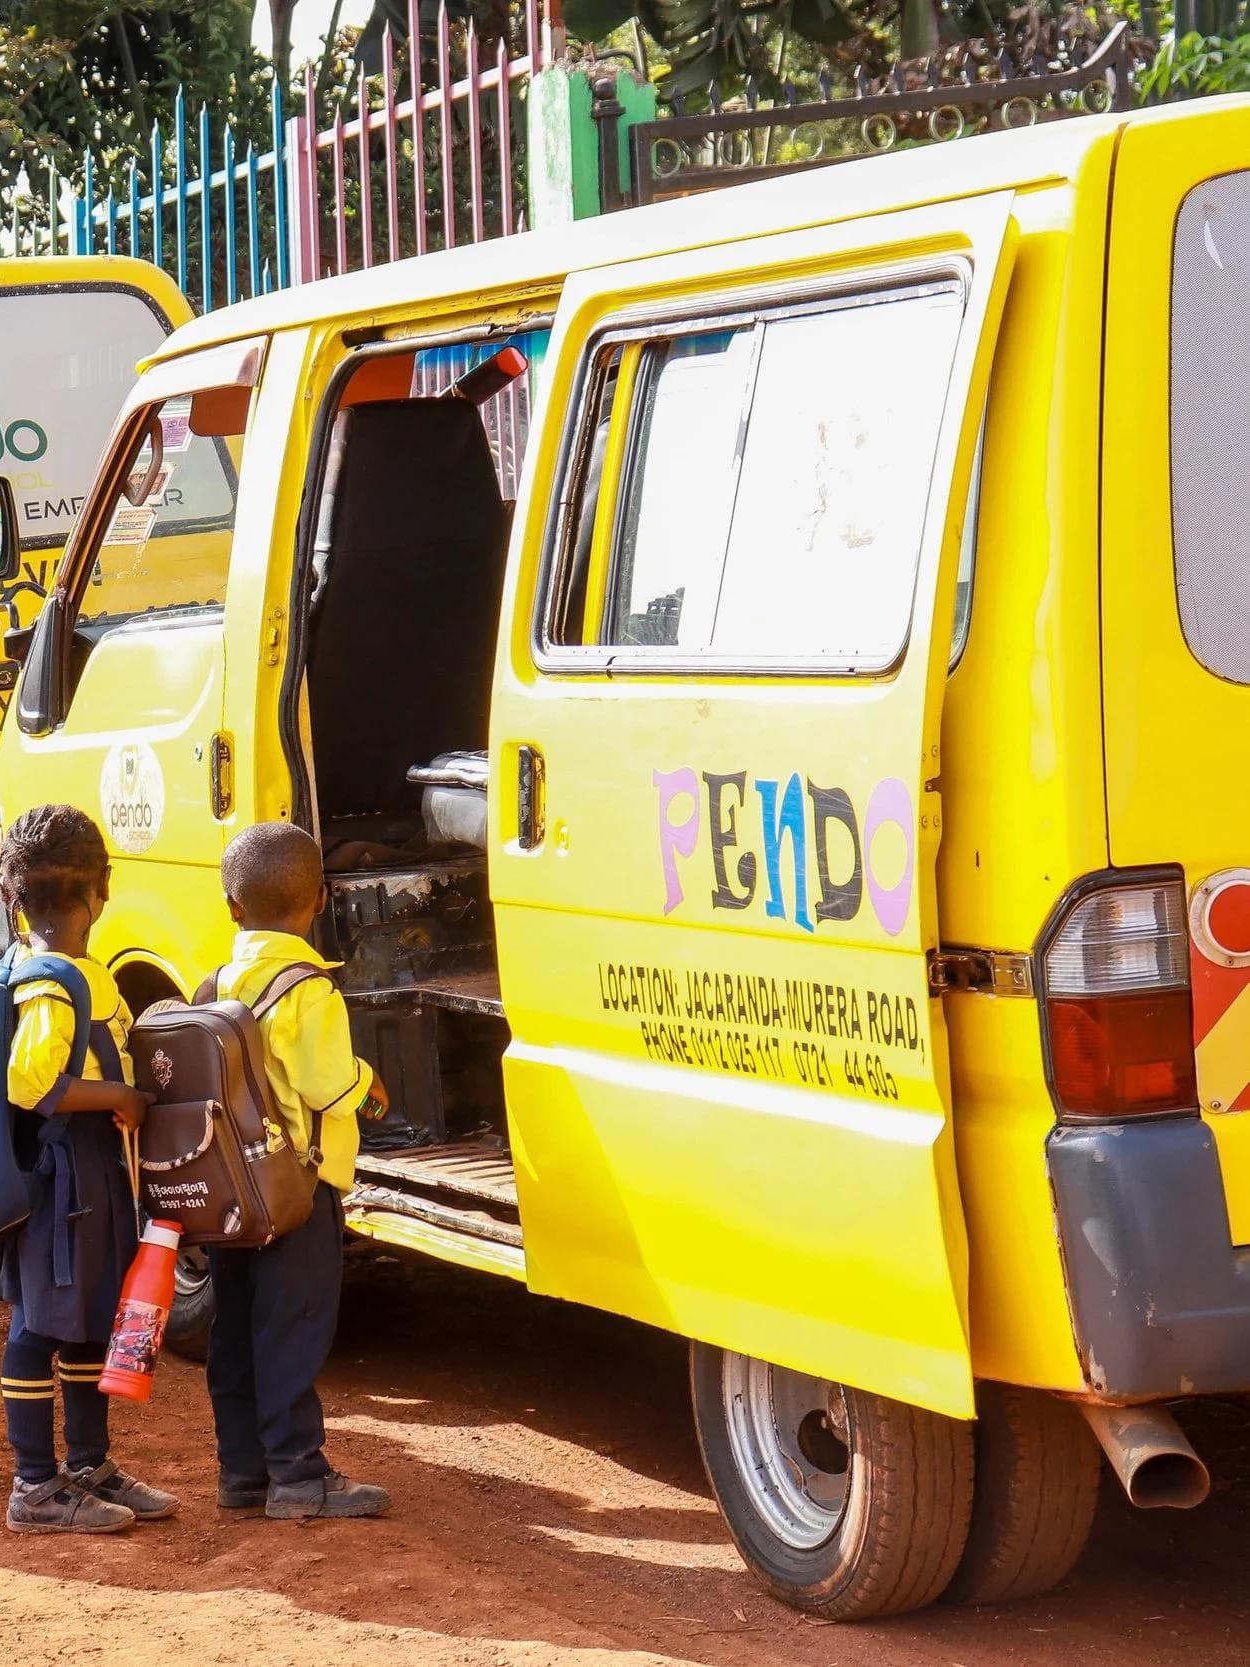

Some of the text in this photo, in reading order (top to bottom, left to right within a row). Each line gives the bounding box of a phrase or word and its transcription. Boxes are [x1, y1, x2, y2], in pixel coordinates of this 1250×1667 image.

[111, 795, 152, 836] pendo
[685, 970, 863, 1041] JACARANDA-MURERA
[641, 1020, 694, 1065] PHONE
